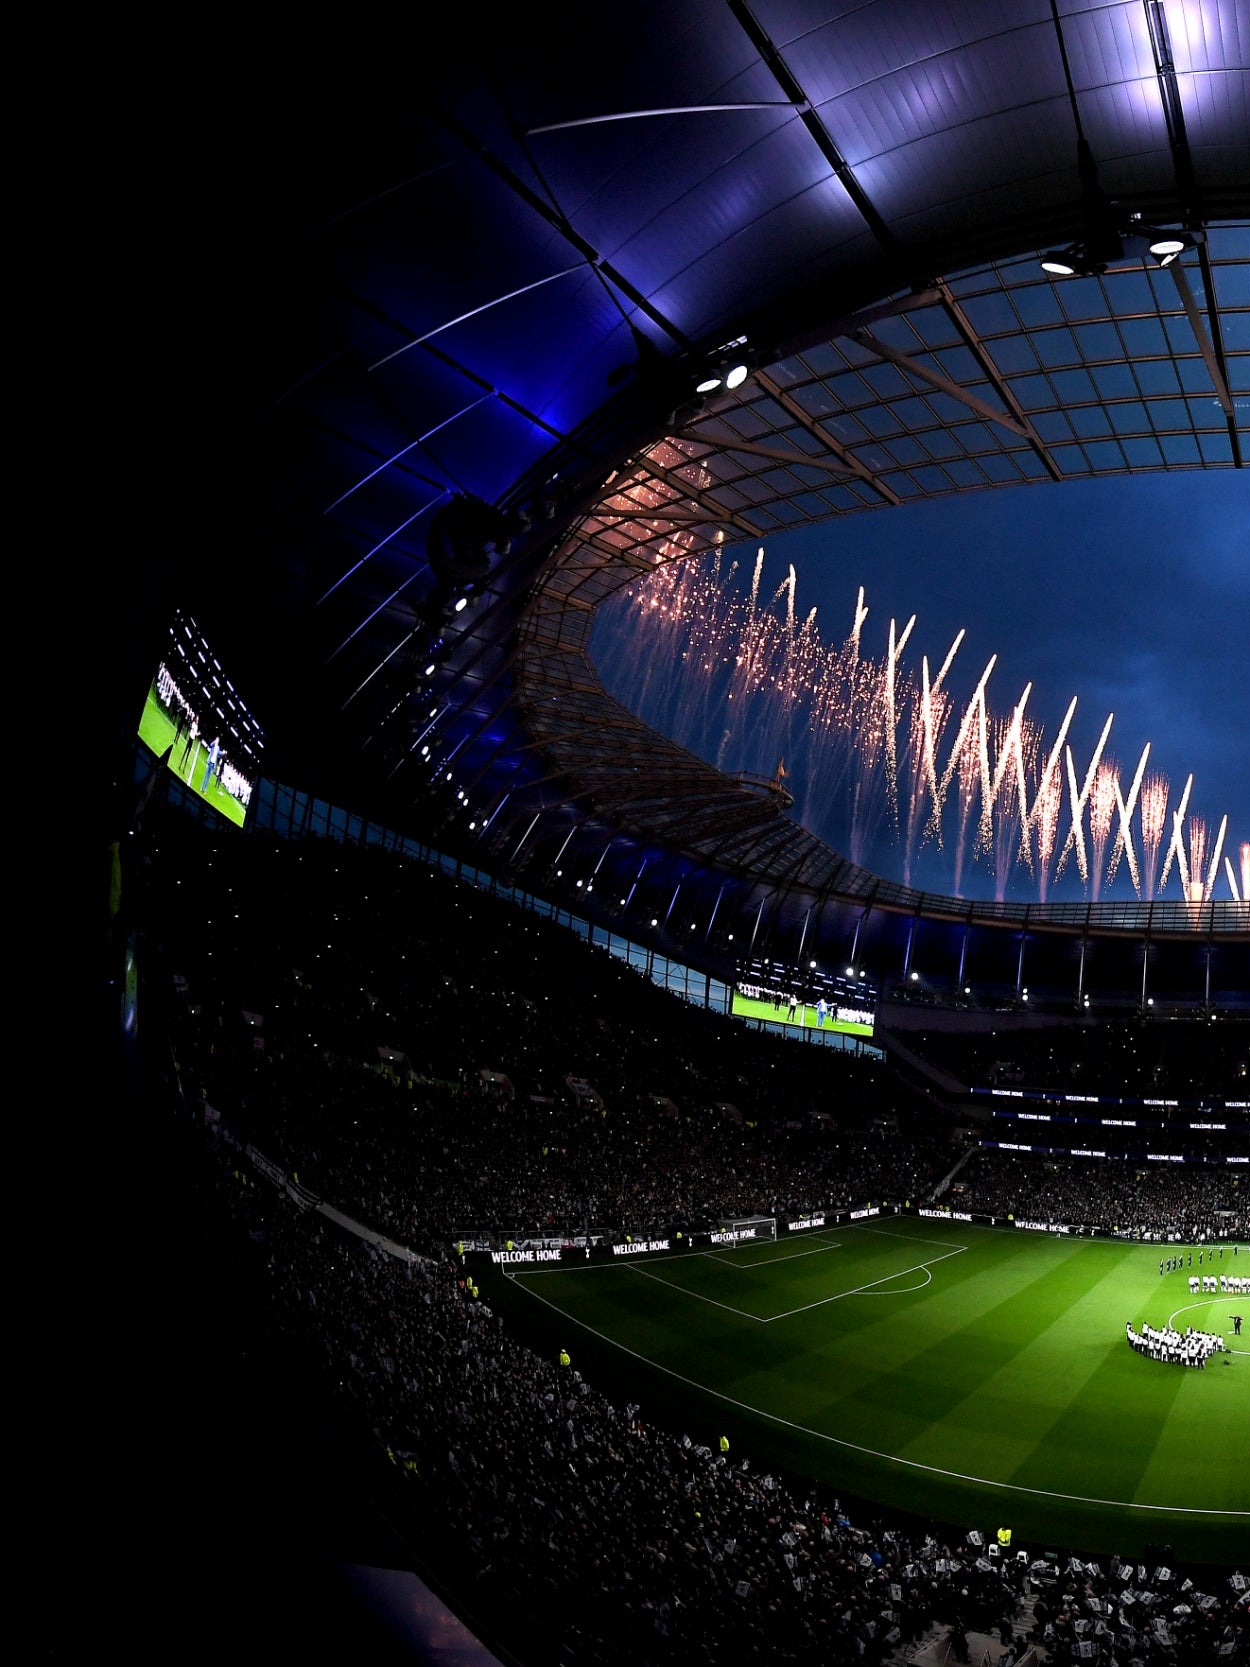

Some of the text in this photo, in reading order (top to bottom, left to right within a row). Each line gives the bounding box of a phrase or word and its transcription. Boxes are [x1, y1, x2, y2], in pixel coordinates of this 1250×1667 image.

[919, 1209, 972, 1221] WELCOME HOME
[789, 1218, 824, 1230] WELCOME HOME
[740, 1229, 756, 1239] HOME
[613, 1242, 648, 1255] WELCOME
[649, 1240, 670, 1251] HOME
[491, 1250, 562, 1263] WELCOME HOME
